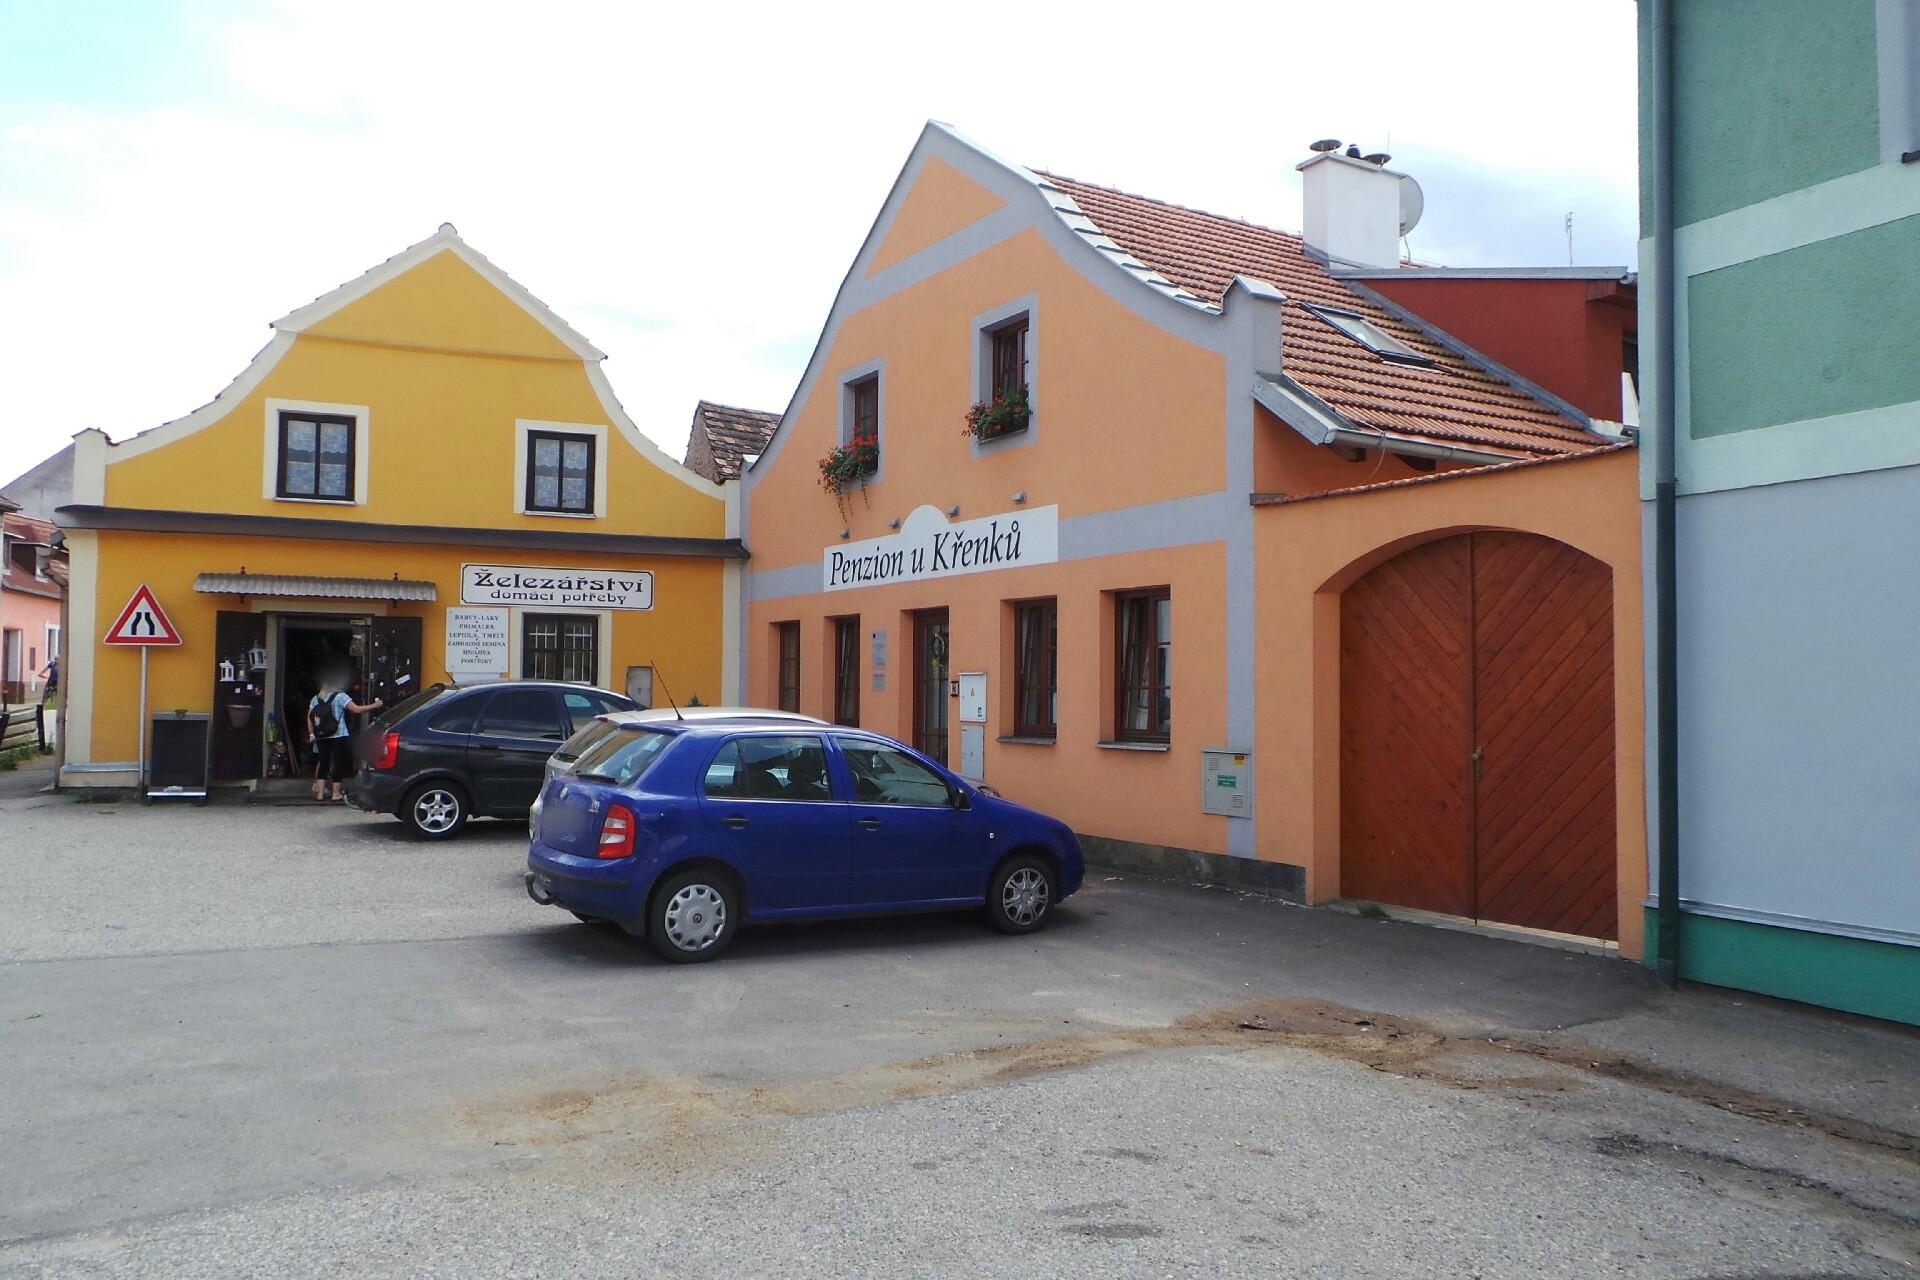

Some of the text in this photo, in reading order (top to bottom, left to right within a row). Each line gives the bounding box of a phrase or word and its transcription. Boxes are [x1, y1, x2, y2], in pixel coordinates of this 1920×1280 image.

[830, 519, 1022, 586] Penzion u Křenků
[474, 568, 643, 593] Železářství
[490, 589, 627, 605] domácí potřeby
